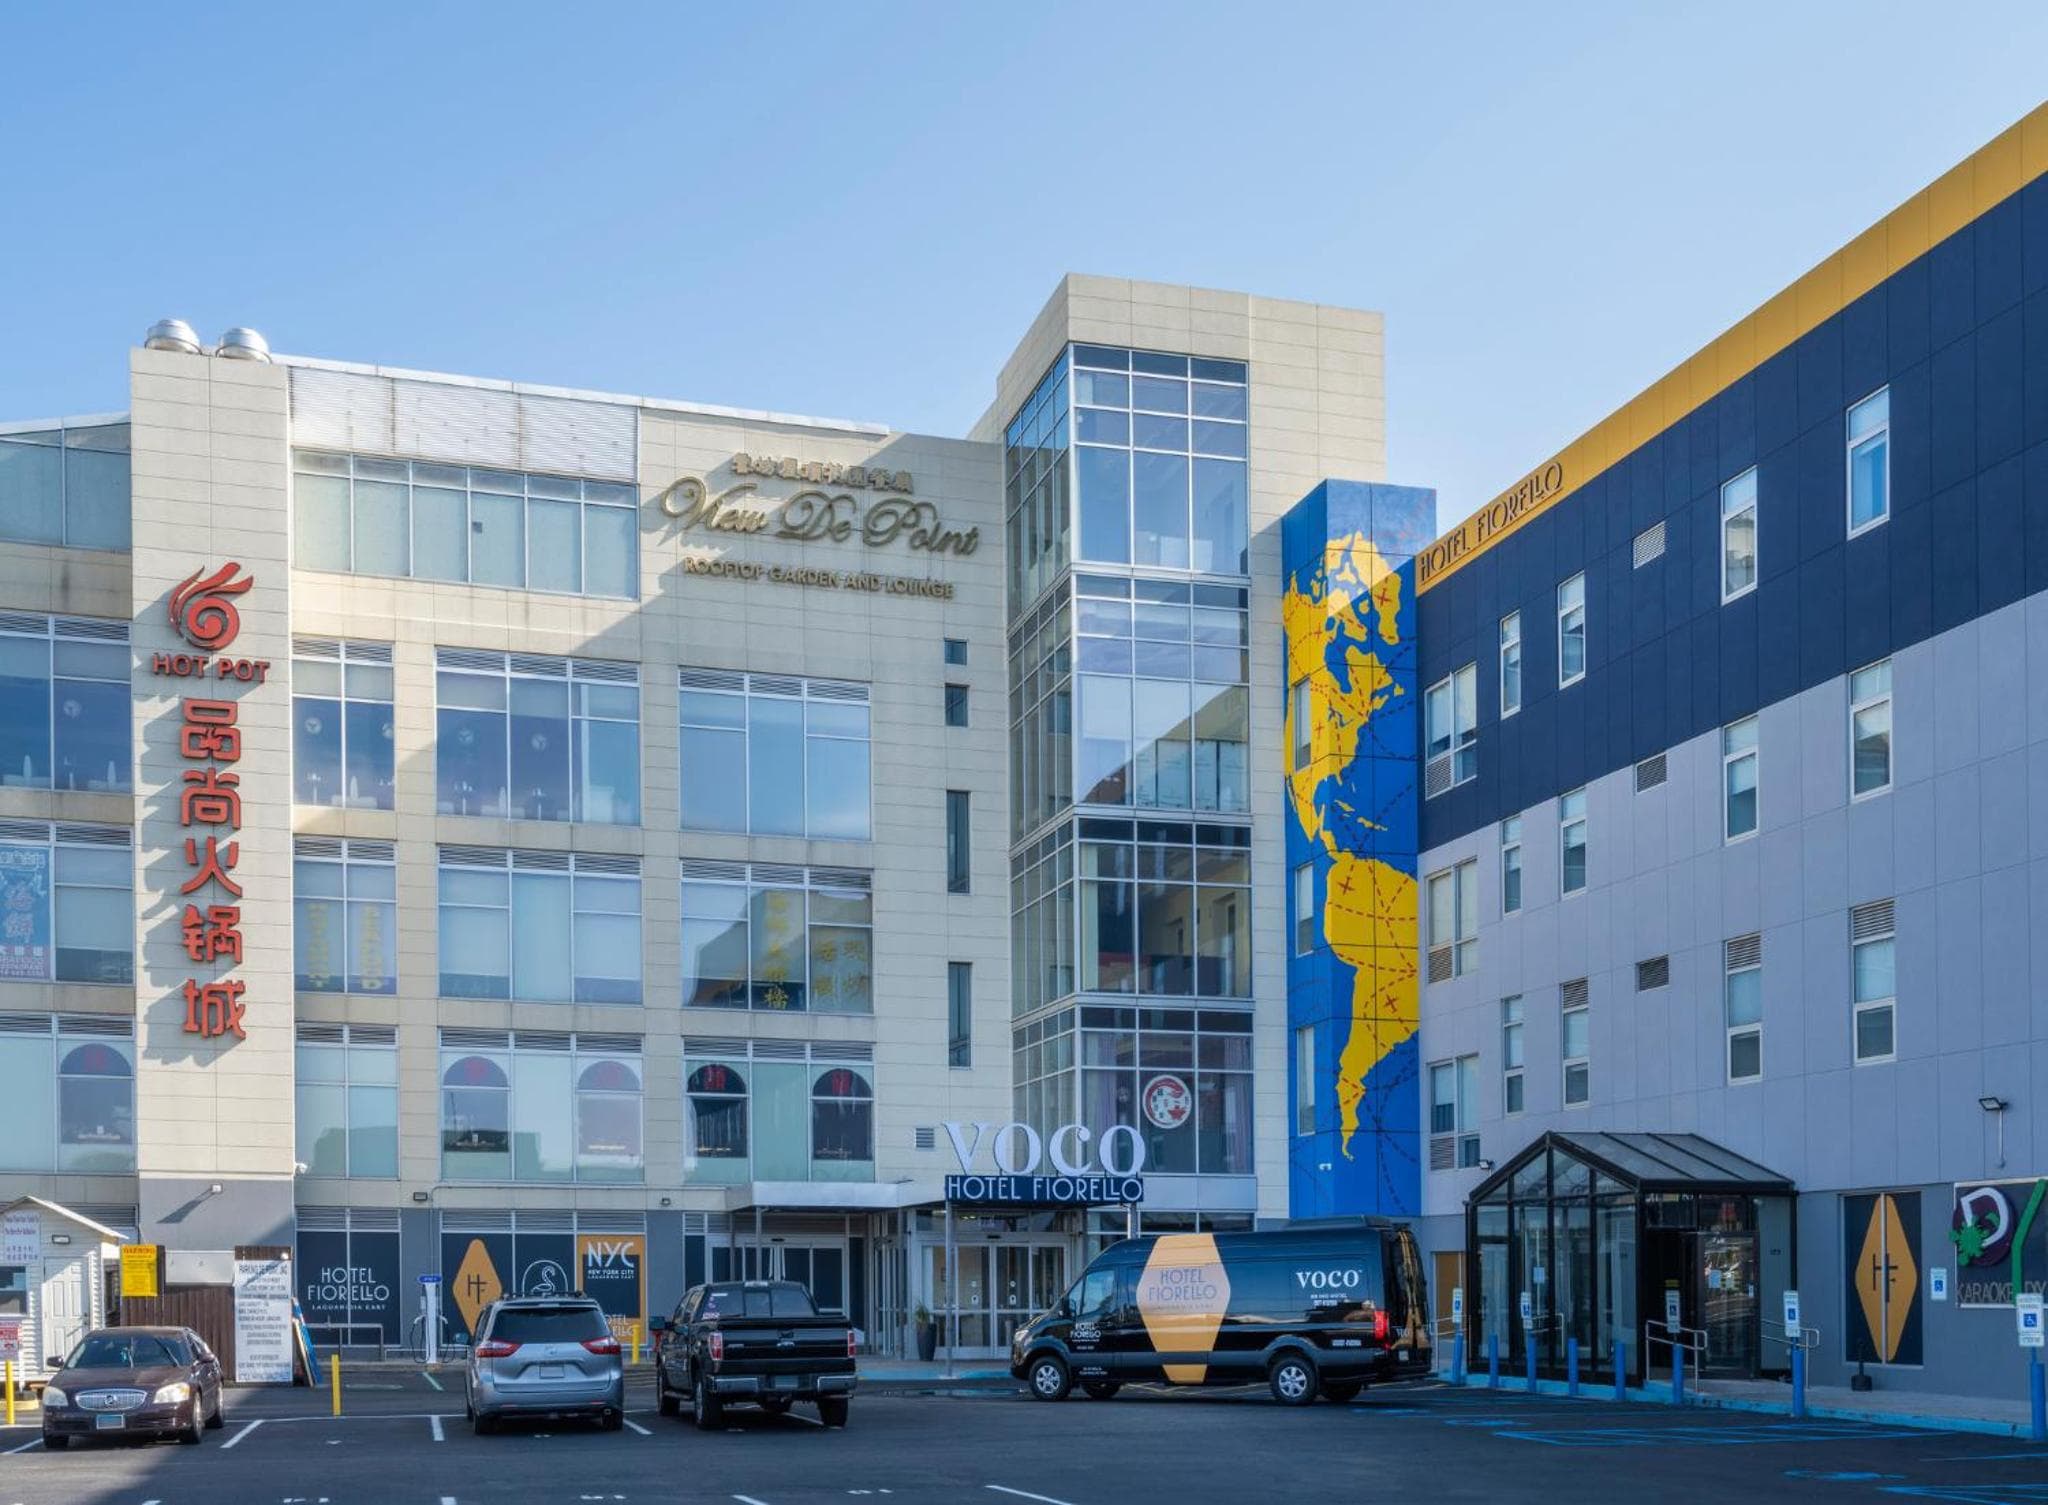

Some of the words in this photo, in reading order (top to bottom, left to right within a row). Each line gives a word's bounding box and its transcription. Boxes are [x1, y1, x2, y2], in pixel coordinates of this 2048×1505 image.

[776, 490, 857, 543] De
[863, 497, 982, 556] Point
[1420, 527, 1471, 581] HOTEL
[1477, 461, 1563, 542] FIORELLO
[684, 556, 763, 581] ROOFTOP
[770, 567, 839, 589] GARDEN
[847, 572, 883, 593] AND
[886, 575, 955, 600] LOUNGE
[152, 652, 209, 679] HOT
[217, 657, 270, 683] POT
[948, 1176, 1021, 1200] HOTEL
[1033, 1177, 1143, 1202] FIORELLO
[587, 1241, 635, 1268] NYC
[321, 1267, 376, 1284] HOTEL
[1161, 1269, 1206, 1285] HOTEL
[307, 1284, 390, 1301] FIORELLO
[1149, 1285, 1217, 1302] FIORELLO
[1957, 1281, 2014, 1304] KARAOKE
